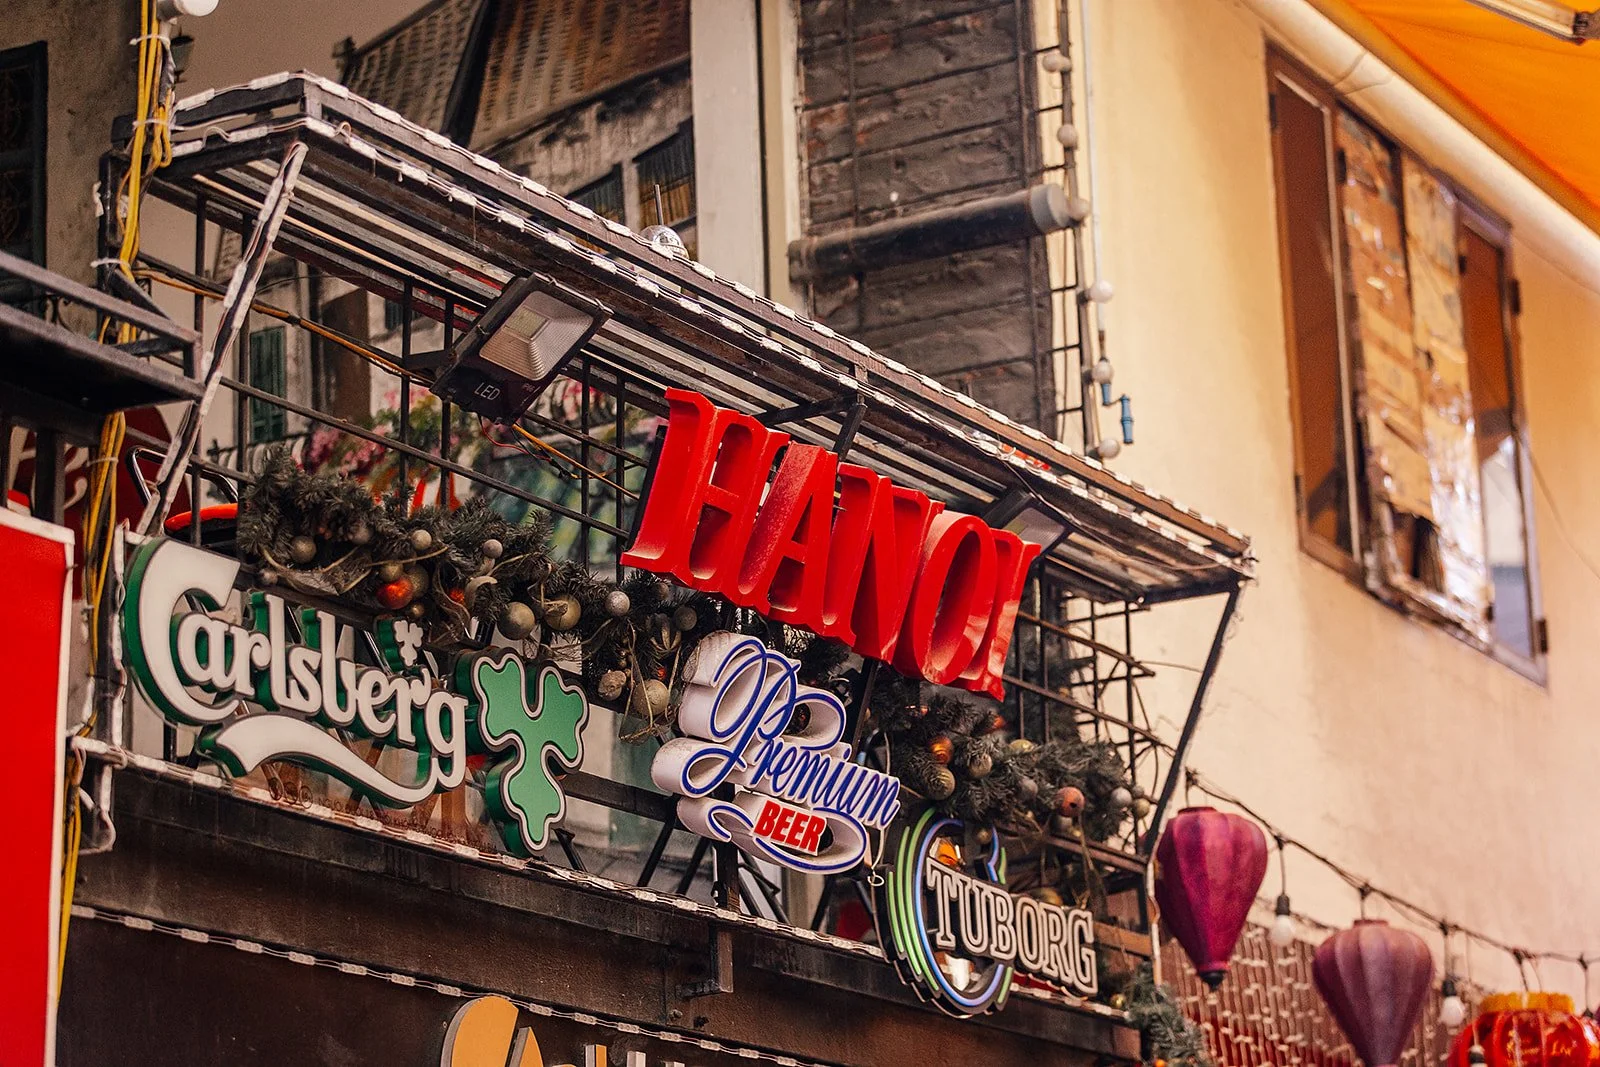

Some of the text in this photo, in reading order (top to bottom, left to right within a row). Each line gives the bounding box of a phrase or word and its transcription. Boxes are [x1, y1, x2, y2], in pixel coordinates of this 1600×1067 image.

[474, 382, 500, 401] LED
[620, 386, 1042, 701] HANOI
[127, 537, 469, 804] Carlsberg
[681, 638, 900, 828] Premium
[753, 799, 827, 853] BEER
[925, 856, 1099, 995] TUBORG
